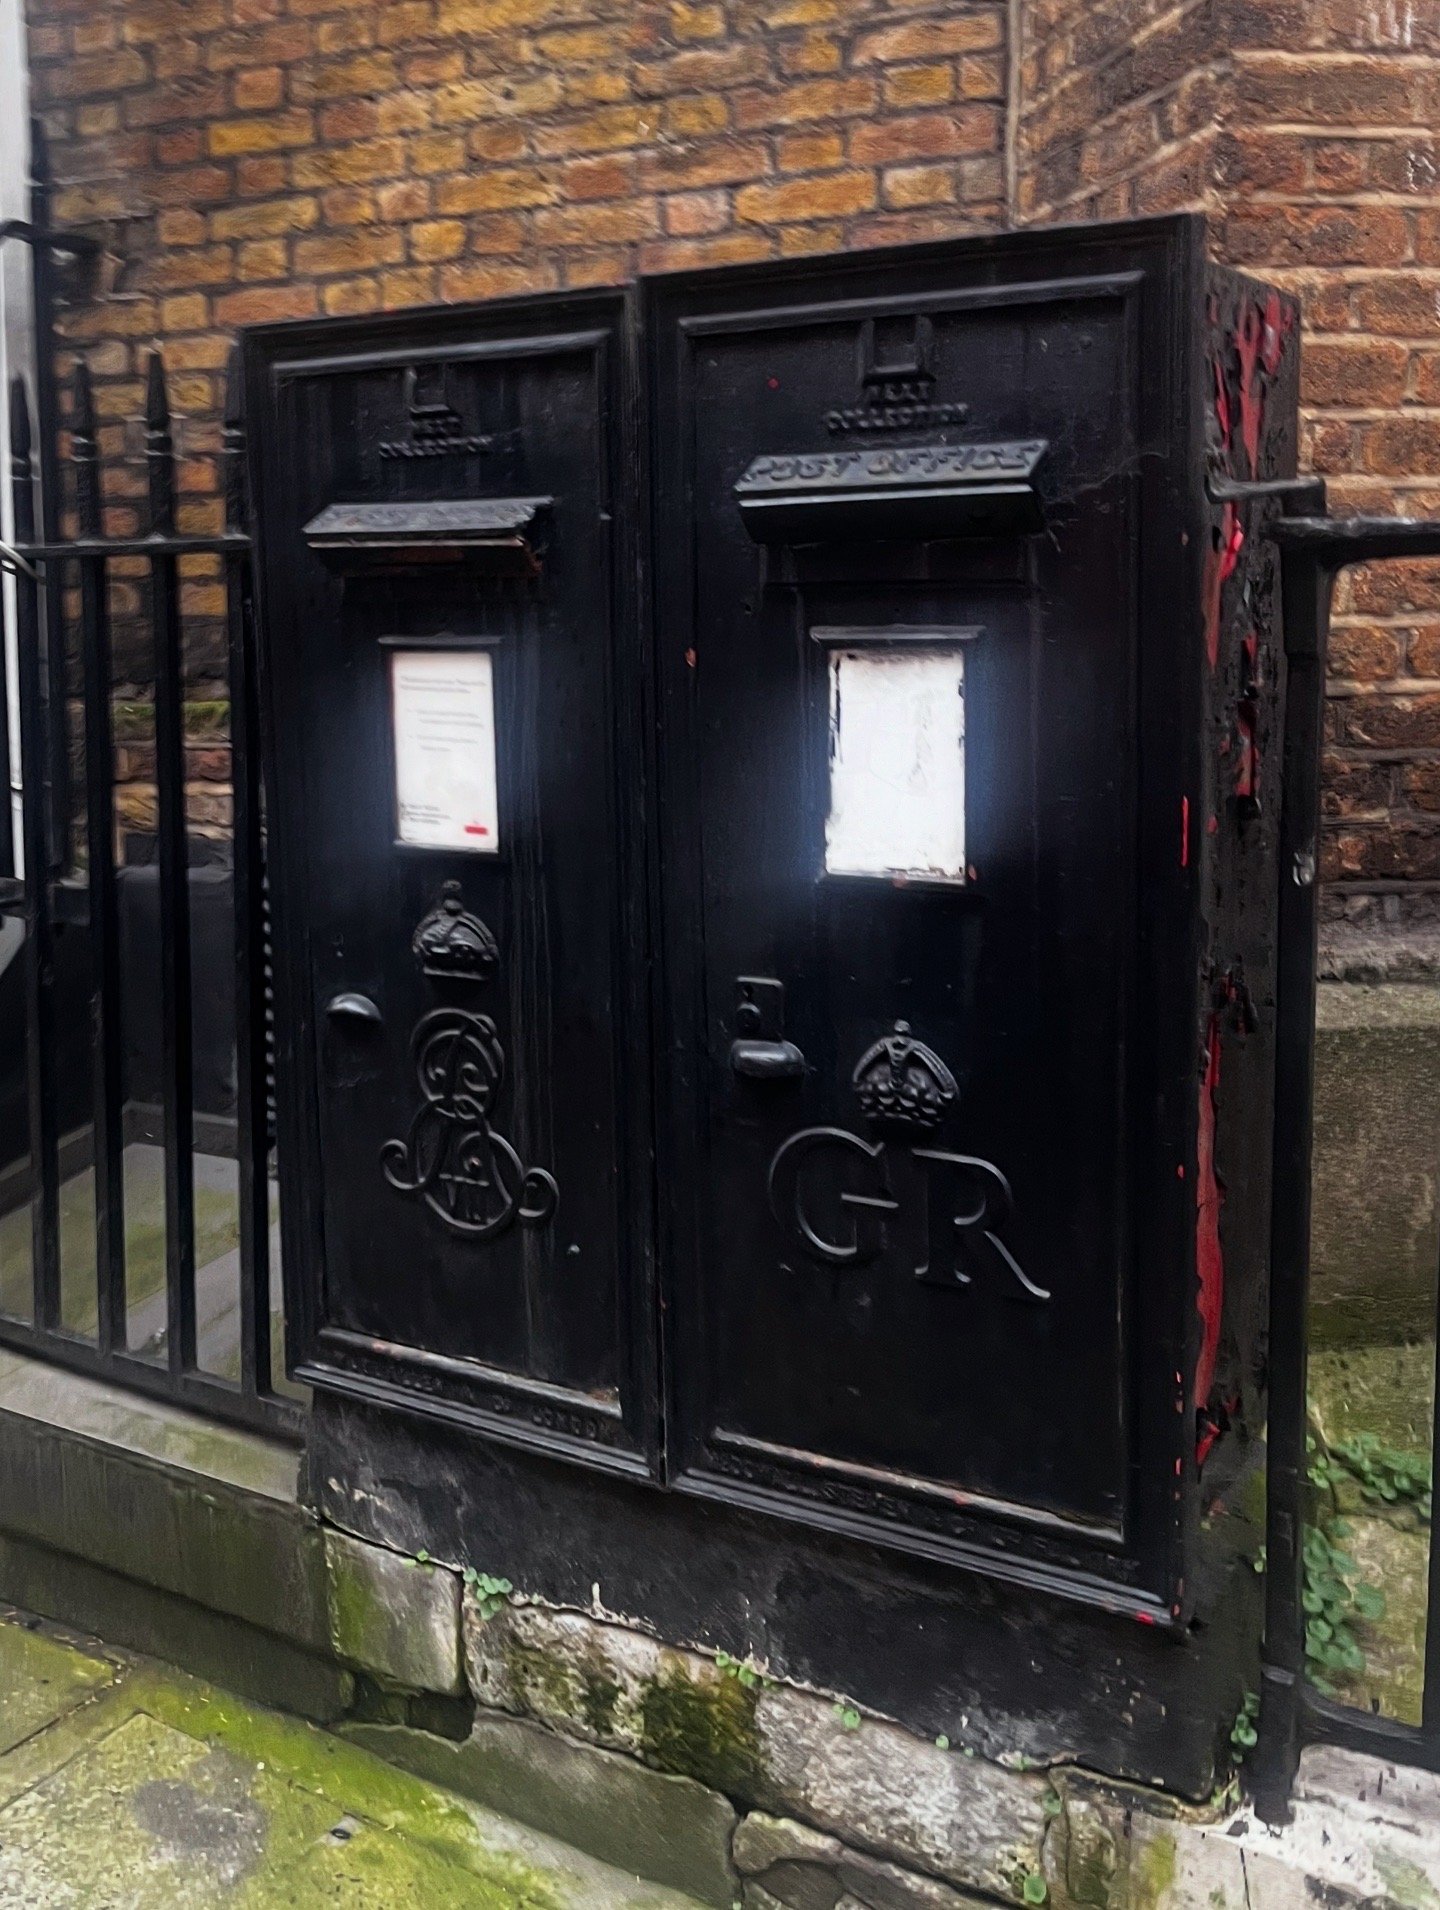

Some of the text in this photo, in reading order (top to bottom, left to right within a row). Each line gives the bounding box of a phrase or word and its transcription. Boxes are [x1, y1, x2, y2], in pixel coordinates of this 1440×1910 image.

[826, 402, 969, 432] COLLECTION
[741, 442, 1043, 484] POST OFFICE
